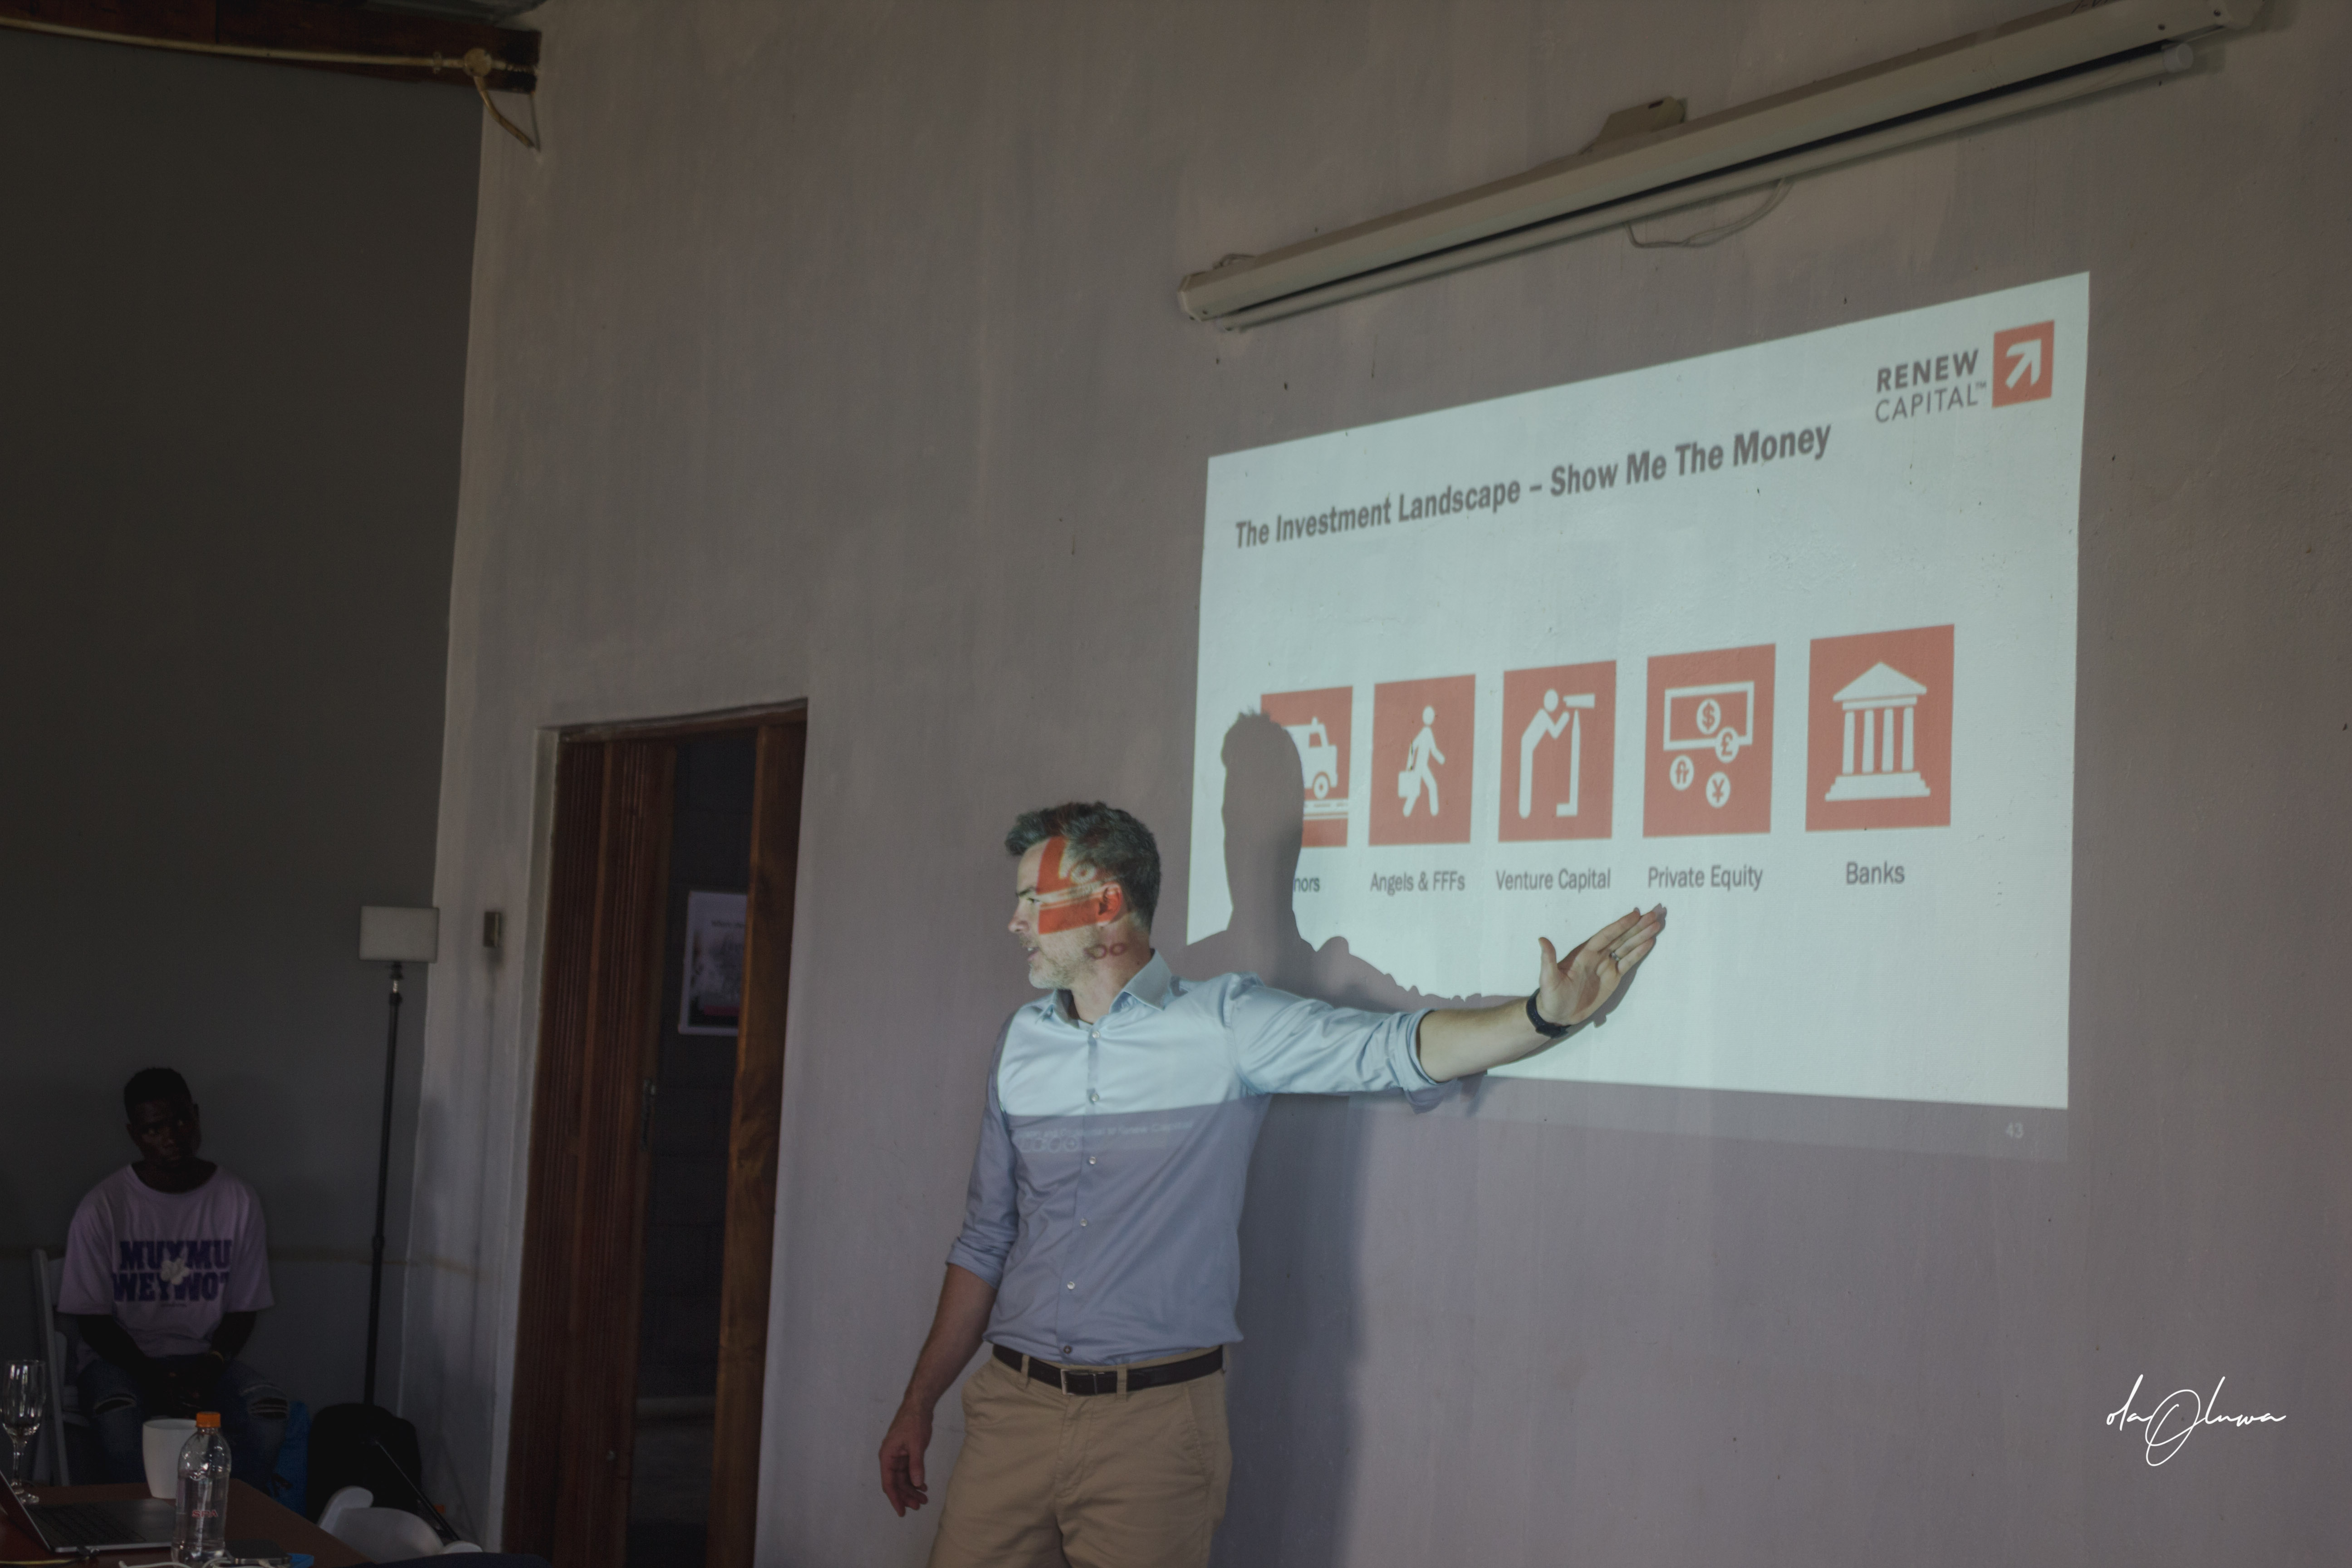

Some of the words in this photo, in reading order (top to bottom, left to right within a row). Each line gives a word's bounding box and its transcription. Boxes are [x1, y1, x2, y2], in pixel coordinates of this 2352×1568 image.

[1877, 348, 1979, 393] RENEW
[1875, 383, 1978, 423] CAPITAL
[1235, 520, 1270, 548] The
[1275, 496, 1392, 543] Investment
[1398, 480, 1521, 522] Landscape
[1550, 464, 1618, 497] Show
[1627, 451, 1667, 484] Me
[1675, 441, 1724, 475] The
[1733, 425, 1831, 467] Money
[1293, 877, 1320, 893] nors
[1371, 872, 1415, 896] Angels
[1418, 871, 1428, 891] &
[1433, 870, 1465, 891] FFFs
[1495, 871, 1554, 891] Venture
[1558, 867, 1611, 892] Capital
[1648, 866, 1705, 888] Private
[1710, 864, 1764, 892] Equity
[1846, 861, 1906, 885] Banks
